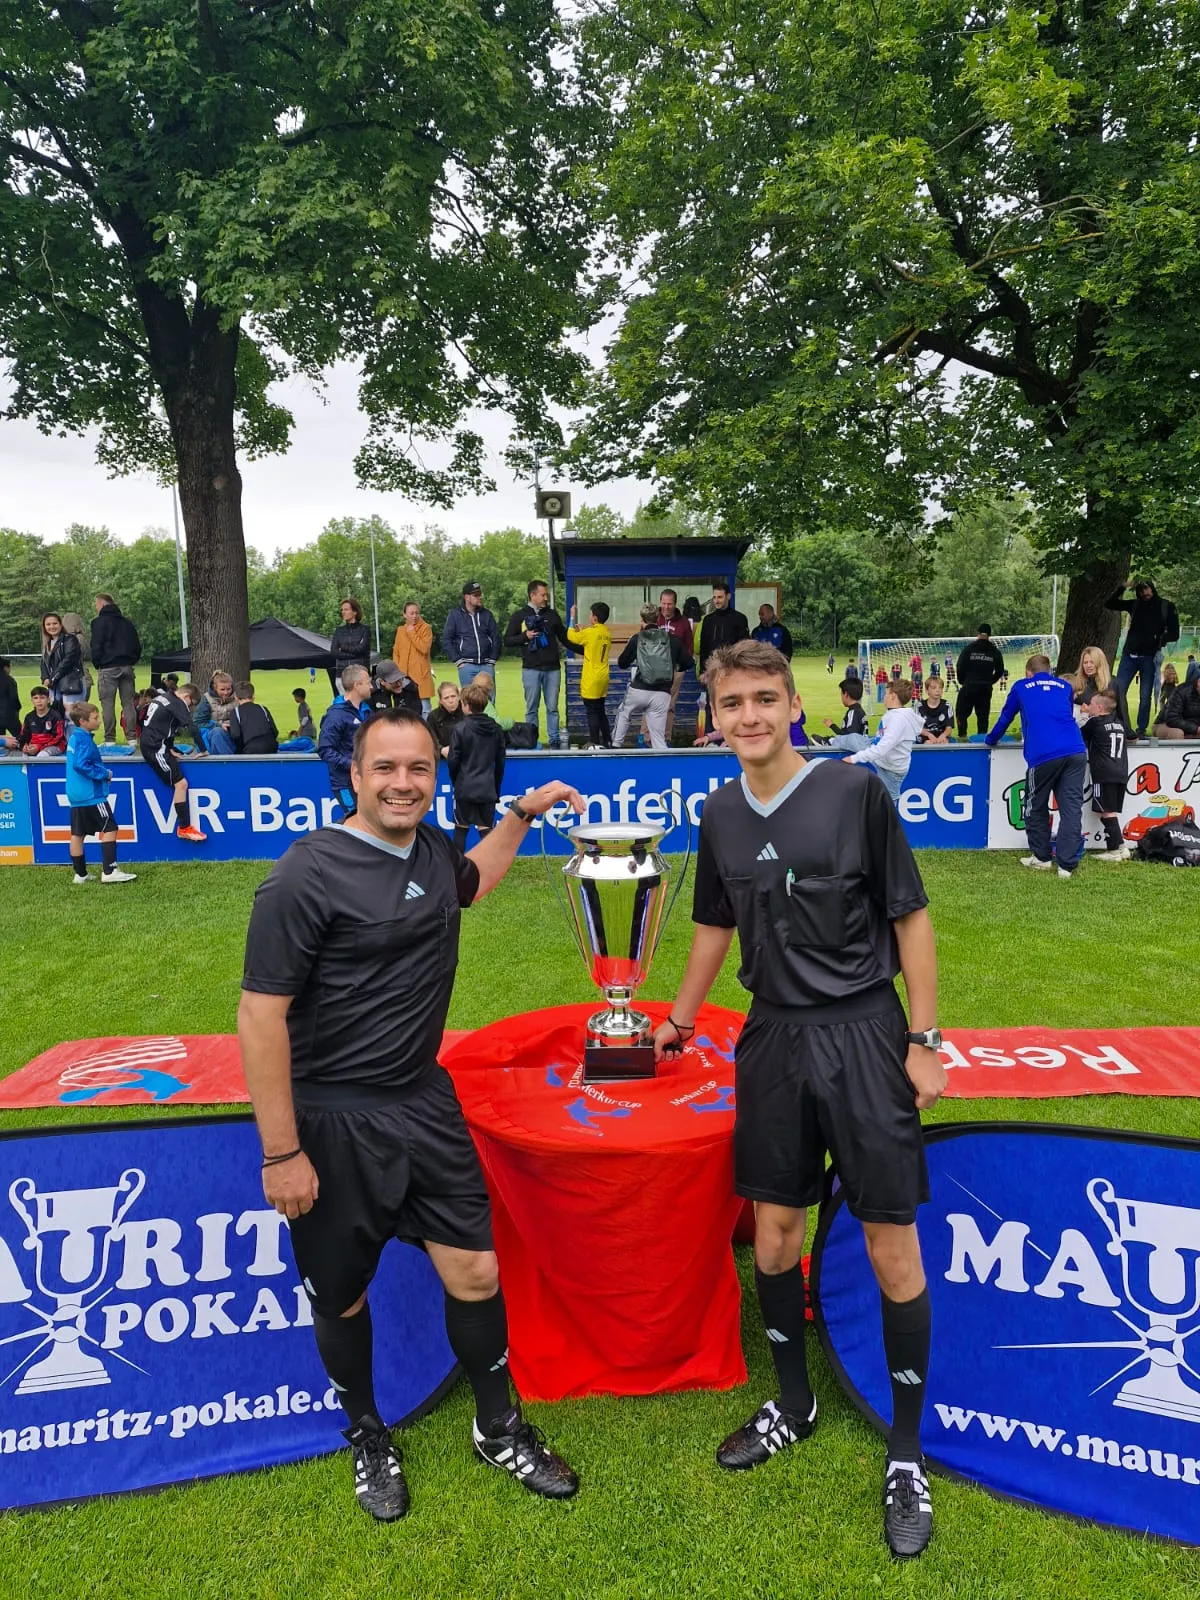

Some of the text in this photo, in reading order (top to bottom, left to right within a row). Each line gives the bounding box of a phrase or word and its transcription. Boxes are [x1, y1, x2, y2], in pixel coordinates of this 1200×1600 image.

[1109, 732, 1124, 759] 17
[898, 775, 974, 823] eG
[934, 1403, 1200, 1485] www.maur
